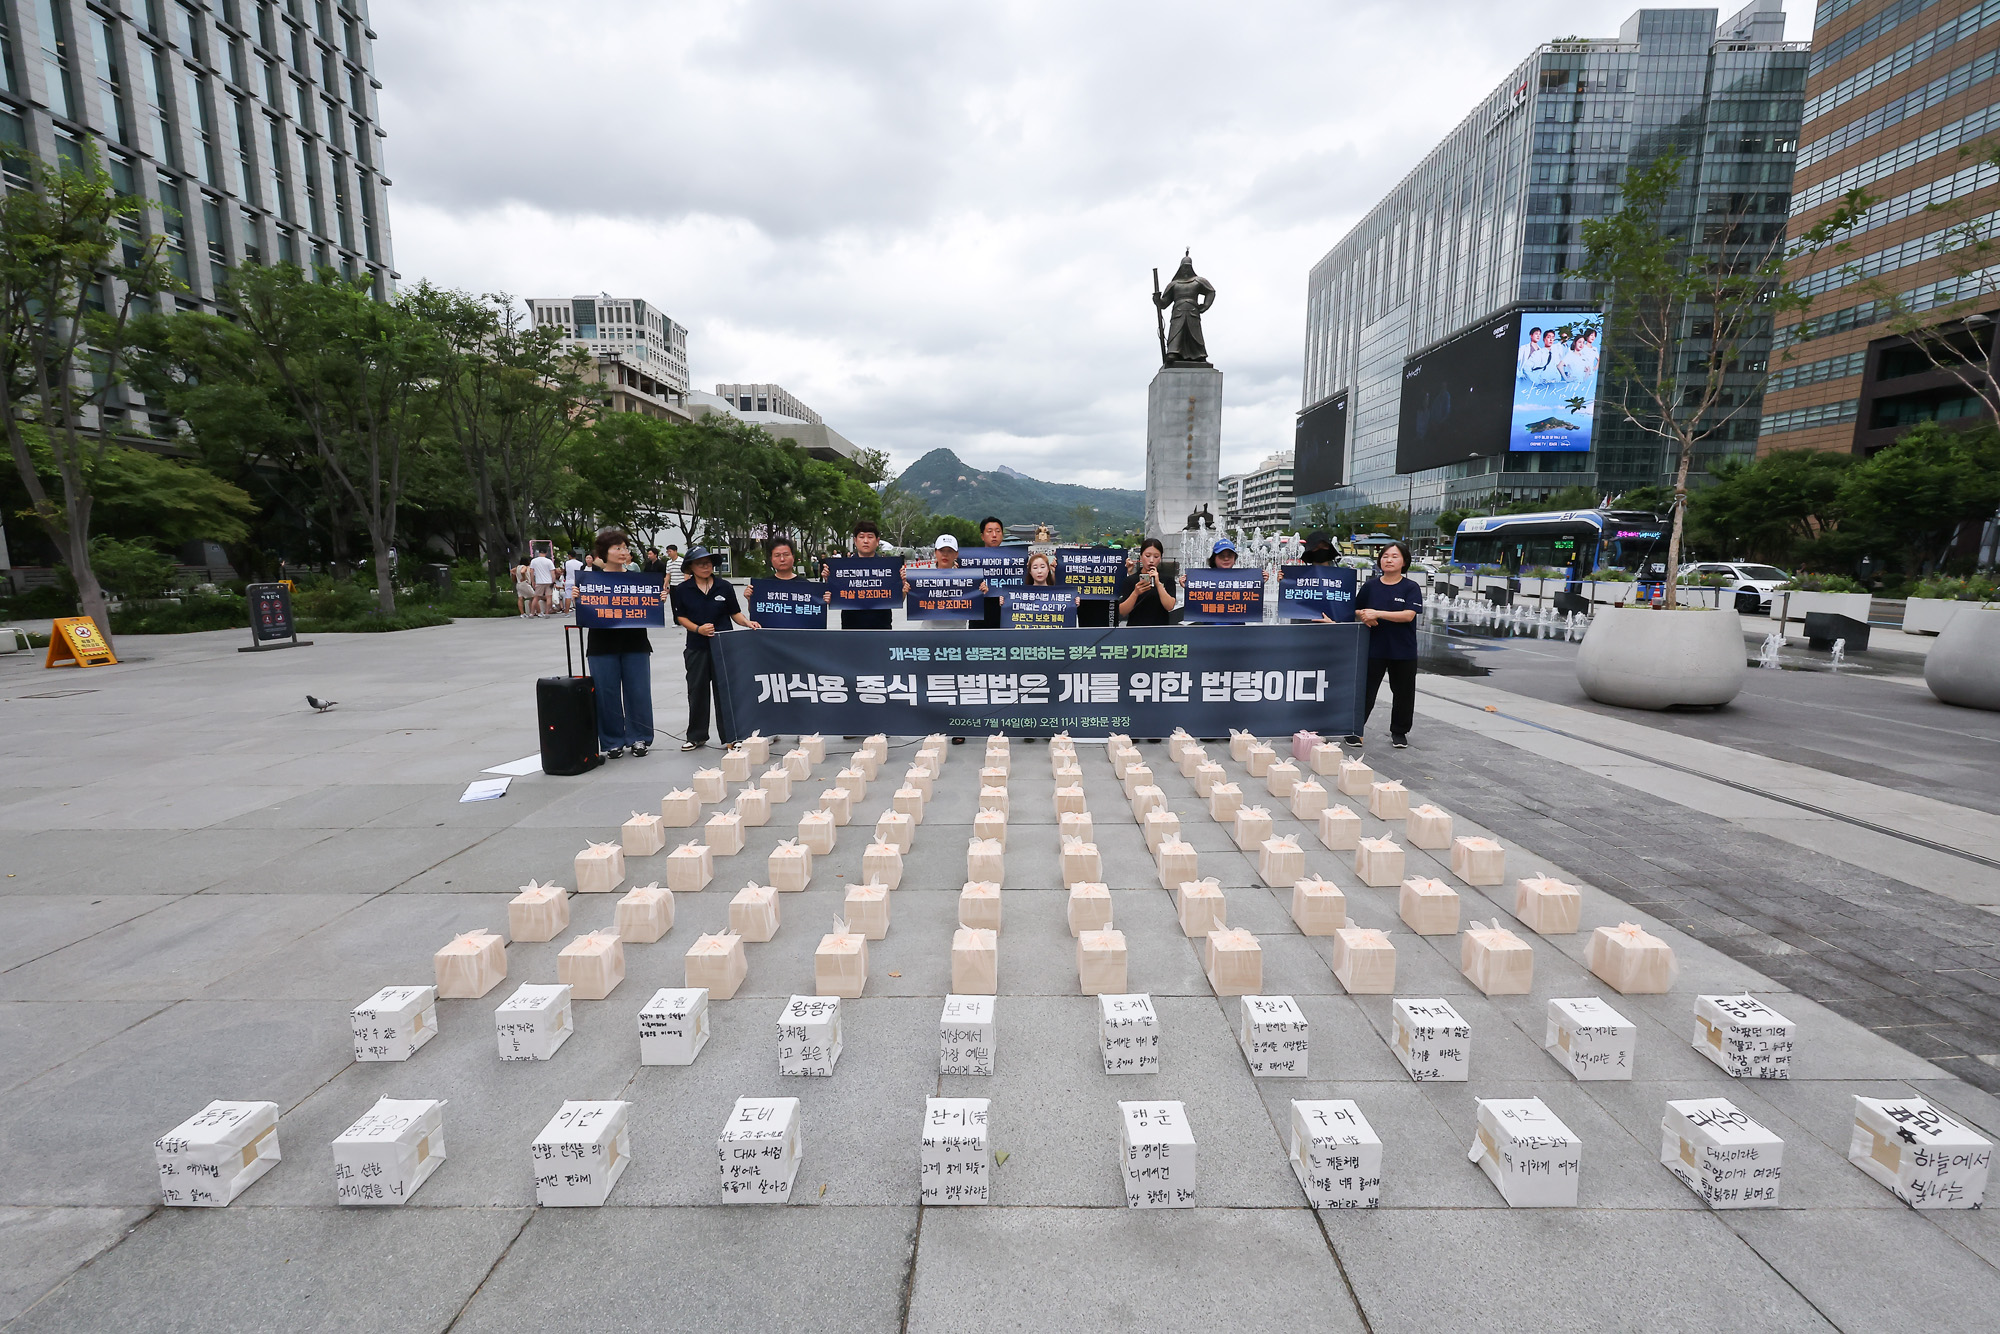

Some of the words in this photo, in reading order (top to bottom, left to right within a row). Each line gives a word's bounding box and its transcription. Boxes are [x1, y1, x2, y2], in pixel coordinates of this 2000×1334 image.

[1561, 512, 1576, 520] EV
[961, 558, 981, 566] 정부가
[982, 558, 1002, 566] 세어야
[1003, 558, 1010, 566] 할
[1012, 558, 1025, 566] 것은
[1062, 555, 1100, 564] 개식용종식법
[1102, 555, 1122, 563] 시행은
[835, 569, 870, 578] 생존견에게
[871, 568, 892, 577] 복날은
[1004, 568, 1024, 576] 아니라
[1065, 565, 1091, 573] 대책없는
[1093, 565, 1117, 573] 쇼인가?
[848, 579, 883, 588] 사형선고다
[915, 579, 951, 588] 생존견에게
[952, 579, 973, 587] 복날은
[1064, 575, 1085, 584] 생존견
[1087, 575, 1115, 584] 보호계획
[1188, 580, 1216, 589] 농림부는
[1218, 580, 1261, 589] 성과홍보말고
[1296, 578, 1319, 587] 방치된
[1321, 578, 1342, 588] 개농장
[579, 583, 611, 594] 농림부는
[613, 585, 660, 594] 성과홍보말고
[839, 590, 857, 599] 학살
[857, 589, 892, 599] 방조마라!
[928, 589, 963, 598] 사형선고다
[1083, 586, 1114, 595] 공개하라!
[580, 595, 609, 605] 현장에
[611, 596, 639, 606] 생존해
[641, 596, 659, 606] 있는
[767, 592, 789, 601] 방치된
[791, 592, 812, 602] 개농장
[1009, 592, 1049, 601] 개식용종식법
[1051, 593, 1072, 602] 시행은
[1188, 591, 1213, 601] 현장에
[1215, 591, 1240, 601] 생존해
[1242, 591, 1260, 601] 있는
[1285, 589, 1323, 600] 방관하는
[1325, 590, 1351, 602] 농림부
[756, 602, 793, 614] 방관하는
[794, 604, 822, 616] 농림부
[919, 600, 936, 610] 학살
[937, 600, 972, 610] 방조마라!
[1012, 602, 1040, 611] 대책없는
[1041, 603, 1067, 611] 쇼인가?
[1201, 603, 1225, 613] 개들을
[1227, 603, 1247, 613] 보라!
[595, 608, 623, 618] 개들을
[625, 609, 647, 618] 보라!
[1011, 613, 1033, 622] 생존견
[1035, 613, 1064, 622] 보호계획
[889, 647, 930, 661] 개식용
[934, 647, 962, 661] 산업
[965, 646, 1006, 661] 생존견
[1010, 646, 1065, 660] 외면하는
[1069, 645, 1097, 660] 정부
[1100, 645, 1128, 659] 규탄
[1131, 644, 1188, 659] 기자회견
[754, 673, 849, 704] 개식용
[855, 674, 918, 706] 종식
[926, 673, 1051, 706] 특별법은
[1058, 673, 1121, 703] 개를
[1128, 671, 1193, 703] 위한
[1201, 670, 1329, 702] 법령이다
[949, 717, 981, 727] 2026년
[983, 717, 999, 728] 7월
[1001, 717, 1037, 728] 14일(화)
[1040, 717, 1059, 727] 오전
[1061, 717, 1078, 727] 11시
[1080, 716, 1109, 727] 광화문
[1111, 716, 1131, 727] 광장
[652, 997, 688, 1009] 소원
[791, 1001, 837, 1017] 왕왕이
[946, 1002, 980, 1016] 보라
[1114, 999, 1149, 1011] 로제
[1255, 1001, 1292, 1013] 복실이
[1714, 999, 1774, 1018] 동백
[1409, 1005, 1455, 1019] 해피
[1454, 1026, 1469, 1039] 삶을
[1766, 1027, 1786, 1037] 기억
[1760, 1041, 1769, 1052] 그
[801, 1046, 822, 1061] 싶은
[966, 1046, 988, 1065] 예쁜
[1440, 1049, 1463, 1061] 바라는
[1617, 1051, 1626, 1067] 뜻
[1728, 1052, 1748, 1066] 가장
[560, 1108, 603, 1128] 이안
[739, 1107, 775, 1122] 도비
[1132, 1109, 1172, 1127] 행운
[1312, 1108, 1355, 1127] 구마
[1502, 1109, 1547, 1122] 비즈
[1686, 1107, 1764, 1133] 대식이
[560, 1142, 585, 1160] 안식을
[1706, 1146, 1759, 1162] 대식이라는
[1326, 1156, 1360, 1171] 개들처럼
[1520, 1159, 1550, 1175] 귀하게
[1558, 1159, 1578, 1176] 여겨
[1913, 1148, 1992, 1177] 하늘에서
[361, 1162, 382, 1178] 선한
[731, 1164, 761, 1178] 생에는
[1703, 1160, 1747, 1183] 고양이가
[339, 1183, 383, 1200] 아이였을
[389, 1180, 404, 1196] 너
[1339, 1177, 1353, 1190] 너무
[1701, 1177, 1738, 1203] 행복해
[1743, 1187, 1776, 1201] 보여요
[1147, 1189, 1170, 1205] 행운이
[1910, 1179, 1964, 1203] 빛나는
